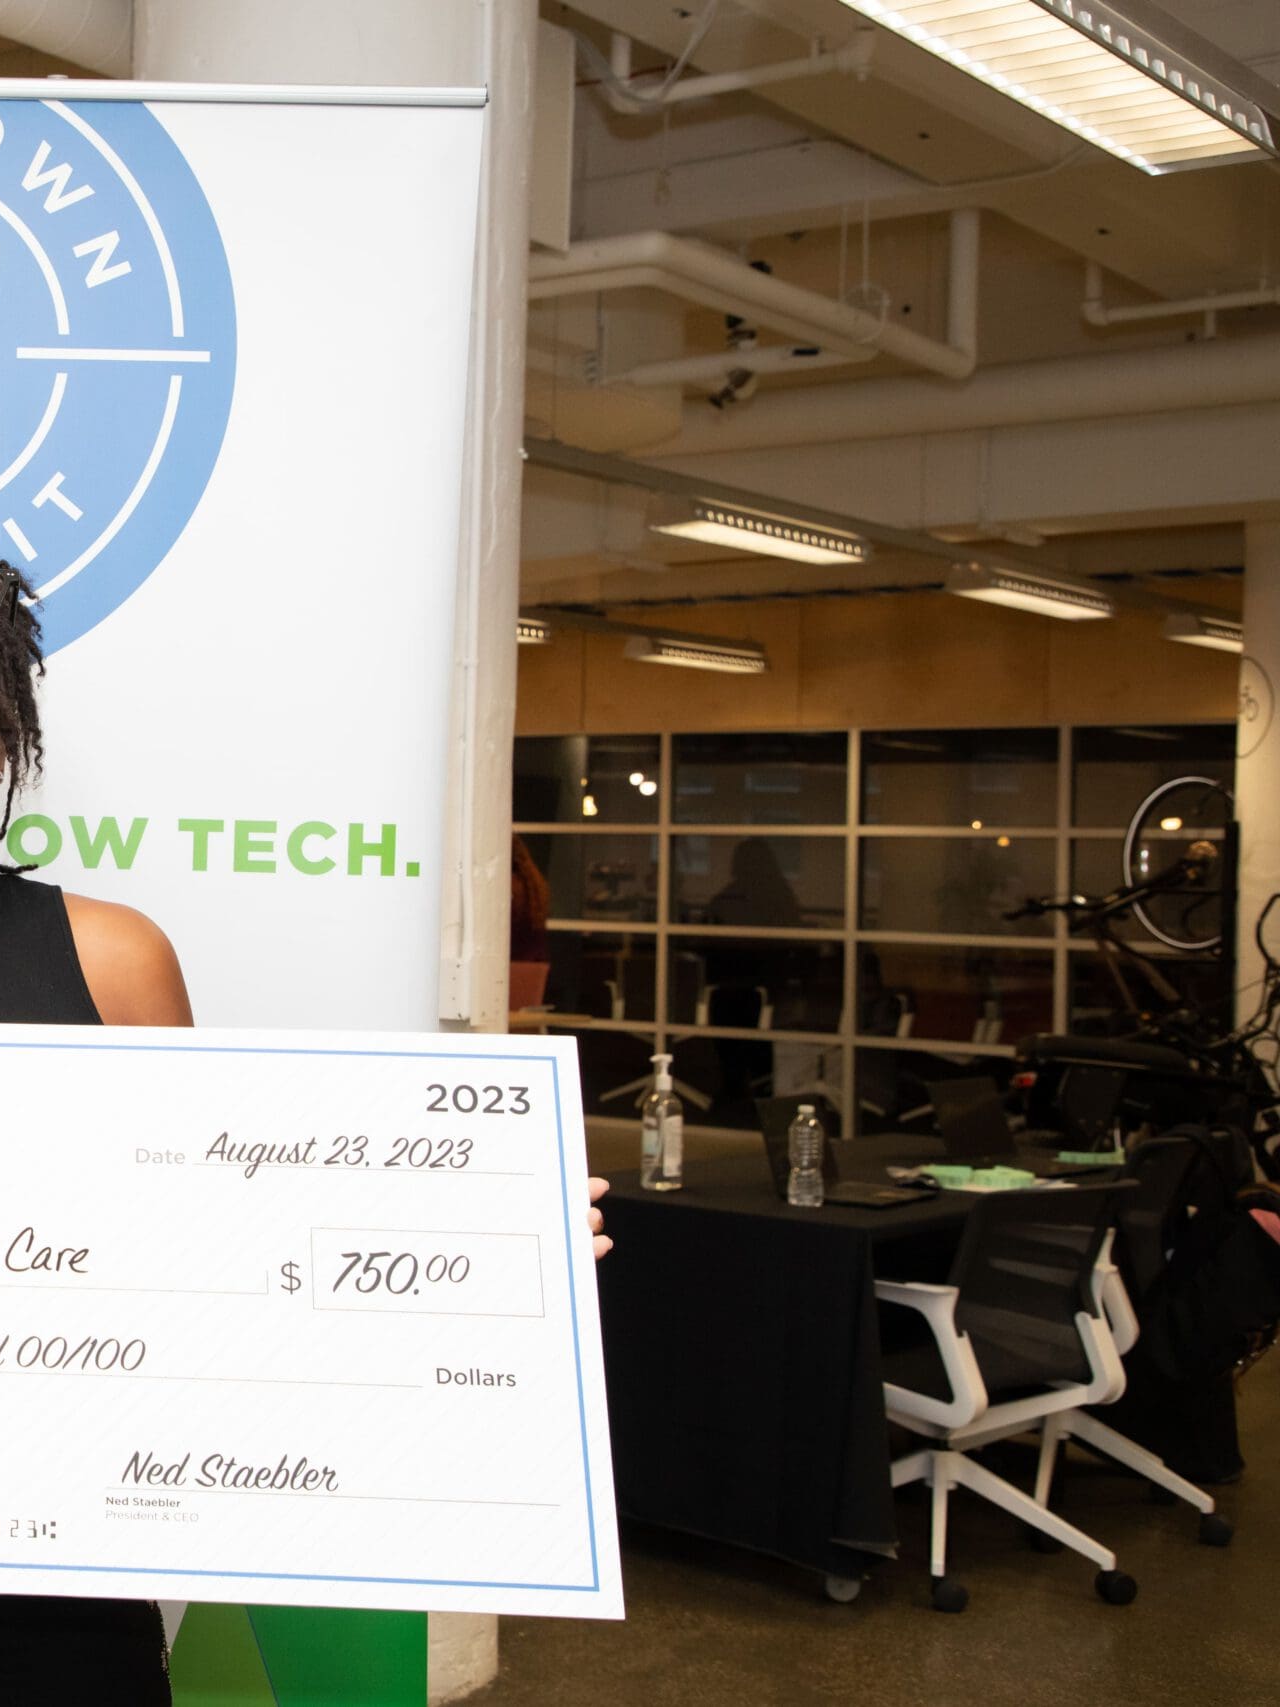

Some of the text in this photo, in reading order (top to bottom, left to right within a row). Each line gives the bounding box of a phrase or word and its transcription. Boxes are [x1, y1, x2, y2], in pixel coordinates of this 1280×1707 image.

[178, 819, 421, 878] TECH.
[426, 1083, 532, 1116] 2023
[135, 1147, 186, 1166] Date
[205, 1131, 317, 1180] August
[384, 1137, 475, 1170] 2023
[4, 1227, 90, 1275] Care
[280, 1260, 302, 1296] $
[16, 1334, 147, 1371] 00/100
[436, 1367, 517, 1388] Dollars
[122, 1451, 341, 1493] Ned Staebler
[105, 1497, 181, 1508] Ned Staebler
[105, 1511, 158, 1521] President
[174, 1513, 200, 1523] CEO
